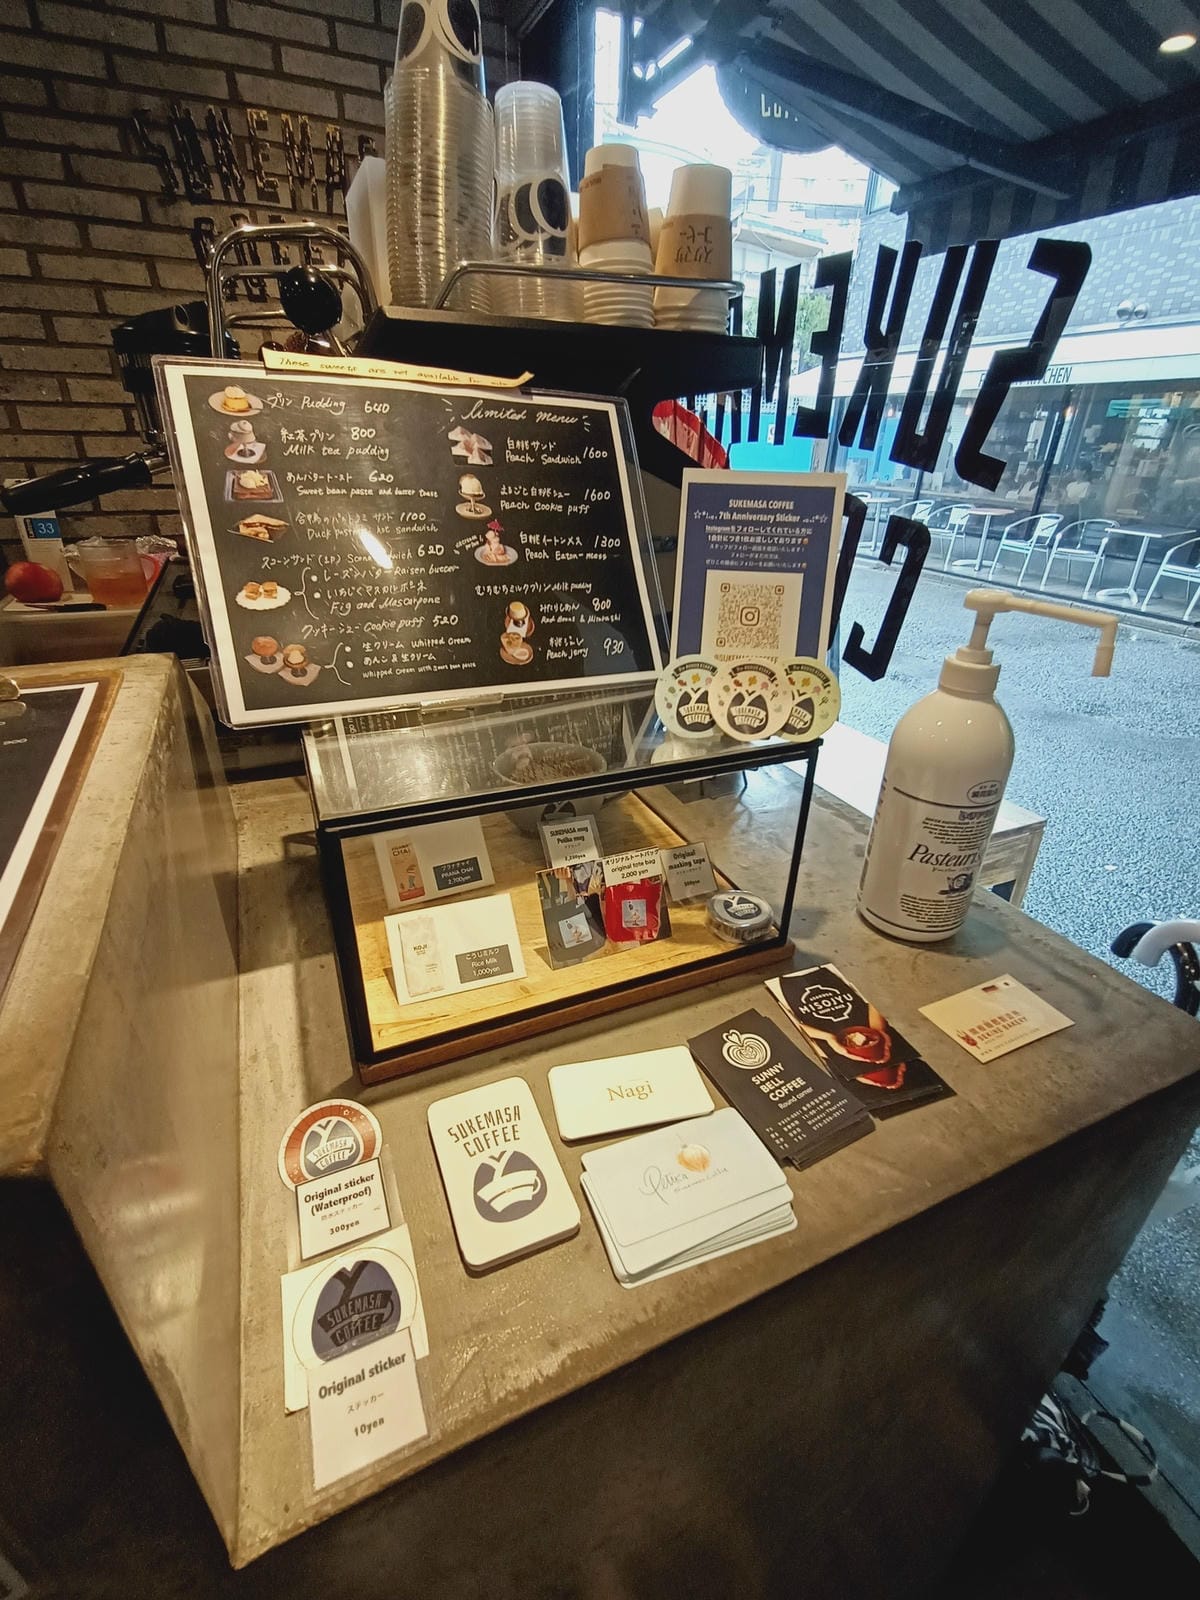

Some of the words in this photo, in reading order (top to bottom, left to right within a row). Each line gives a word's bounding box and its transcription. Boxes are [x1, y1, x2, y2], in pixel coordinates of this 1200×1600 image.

[301, 396, 346, 416] Pudding
[364, 400, 390, 414] 640
[350, 426, 376, 441] 800
[322, 446, 341, 456] tea
[345, 444, 390, 461] pudding
[505, 450, 535, 462] Peach
[582, 446, 608, 459] 1600
[368, 469, 395, 484] 620
[326, 486, 347, 495] bean
[584, 488, 611, 501] 1600
[500, 500, 530, 511] Peach
[567, 504, 590, 516] puff
[728, 499, 767, 508] SUKEMASA
[768, 500, 794, 510] COFFEE
[399, 511, 427, 522] 1100
[719, 511, 731, 520] 7th
[732, 512, 774, 523] Anniversary
[776, 513, 800, 523] Sticker
[37, 523, 54, 534] 33
[307, 528, 332, 541] Duck
[594, 535, 621, 549] 1300
[417, 544, 445, 558] 620
[525, 549, 549, 562] Peach
[330, 602, 351, 617] Fig
[356, 599, 375, 610] and
[592, 597, 612, 612] 800
[396, 617, 425, 632] puff
[432, 614, 459, 627] 520
[603, 637, 624, 656] 930
[466, 948, 500, 960] こうじミルク
[471, 960, 485, 968] Rice
[473, 966, 500, 977] 1,000yen
[751, 1062, 785, 1085] SUNNY
[607, 1080, 654, 1102] Nagi
[759, 1077, 785, 1094] BELL
[769, 1076, 807, 1102] COFFEE
[777, 1097, 797, 1110] Round
[447, 1105, 521, 1143] SUKEMASA
[463, 1124, 520, 1157] COFFEE
[320, 1151, 346, 1168] COFFEE
[304, 1184, 342, 1203] Original
[344, 1173, 375, 1190] sticker
[311, 1186, 372, 1216] (Waterproof)
[330, 1220, 360, 1235] 300yen
[327, 1294, 382, 1327] SUKEMASA
[335, 1314, 377, 1344] COFFEE
[318, 1368, 365, 1400] Original
[368, 1353, 406, 1379] sticker
[347, 1392, 384, 1414] ステッカー
[354, 1416, 385, 1437] 10yen
